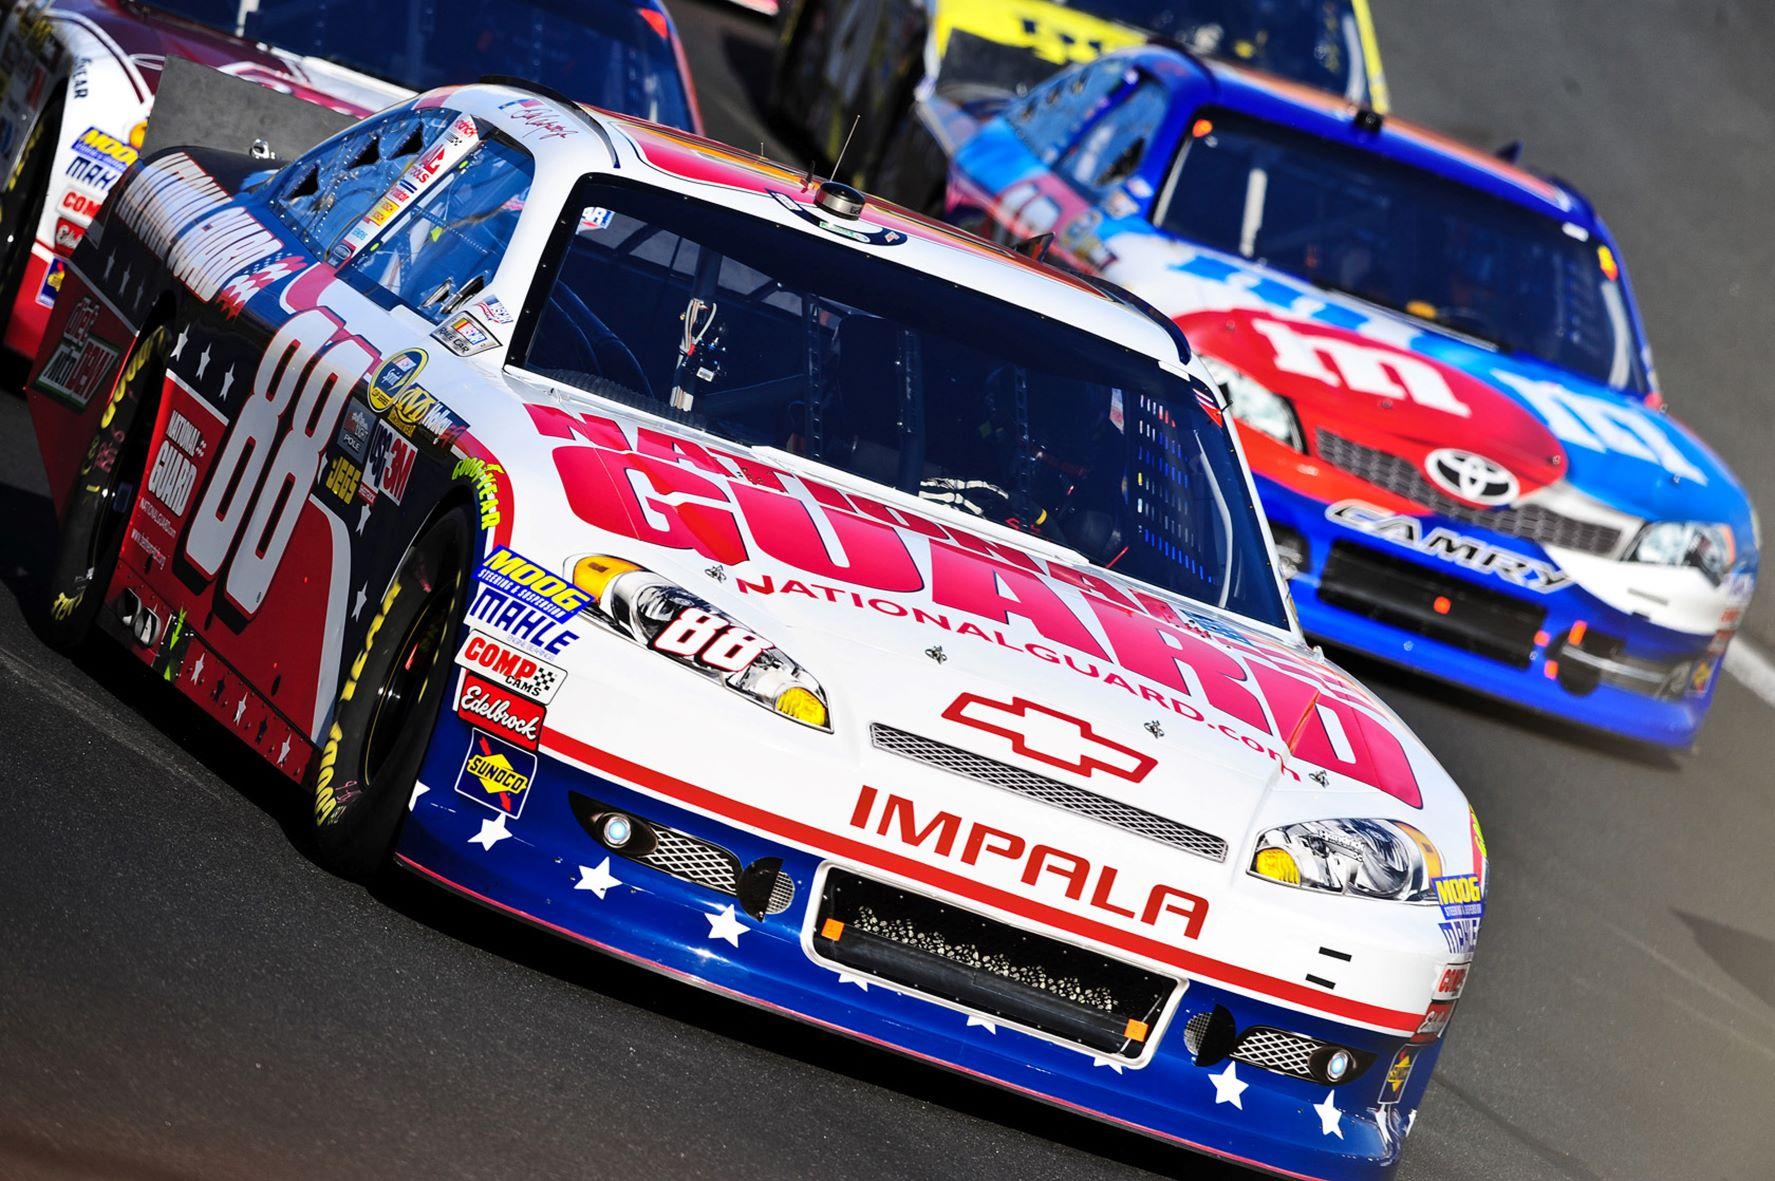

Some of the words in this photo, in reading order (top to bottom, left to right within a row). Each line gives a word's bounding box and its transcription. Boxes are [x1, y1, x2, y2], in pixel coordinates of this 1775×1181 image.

[66, 156, 116, 190] MAH
[82, 128, 139, 167] MOO
[63, 191, 101, 220] COM
[166, 409, 201, 457] NATIONAL
[343, 433, 361, 452] POLE
[148, 440, 198, 517] GUARD
[185, 306, 379, 615] 88
[325, 456, 362, 505] JEGS
[382, 437, 416, 502] 3M
[1325, 498, 1578, 594] CAMRY
[477, 568, 511, 591] STEERING
[517, 585, 567, 619] SUSPENSION
[483, 549, 590, 612] MOOG
[469, 587, 580, 656] MAHLE
[552, 445, 1424, 810] GUARD
[653, 606, 774, 672] 88
[464, 636, 538, 682] COMP
[505, 674, 543, 698] CAMS
[735, 574, 1302, 782] NATIONALGUARD.com
[460, 684, 538, 741] Edelbrock
[469, 756, 527, 794] SUNOCO
[849, 784, 1210, 941] IMPALA
[1435, 877, 1481, 905] MOOG
